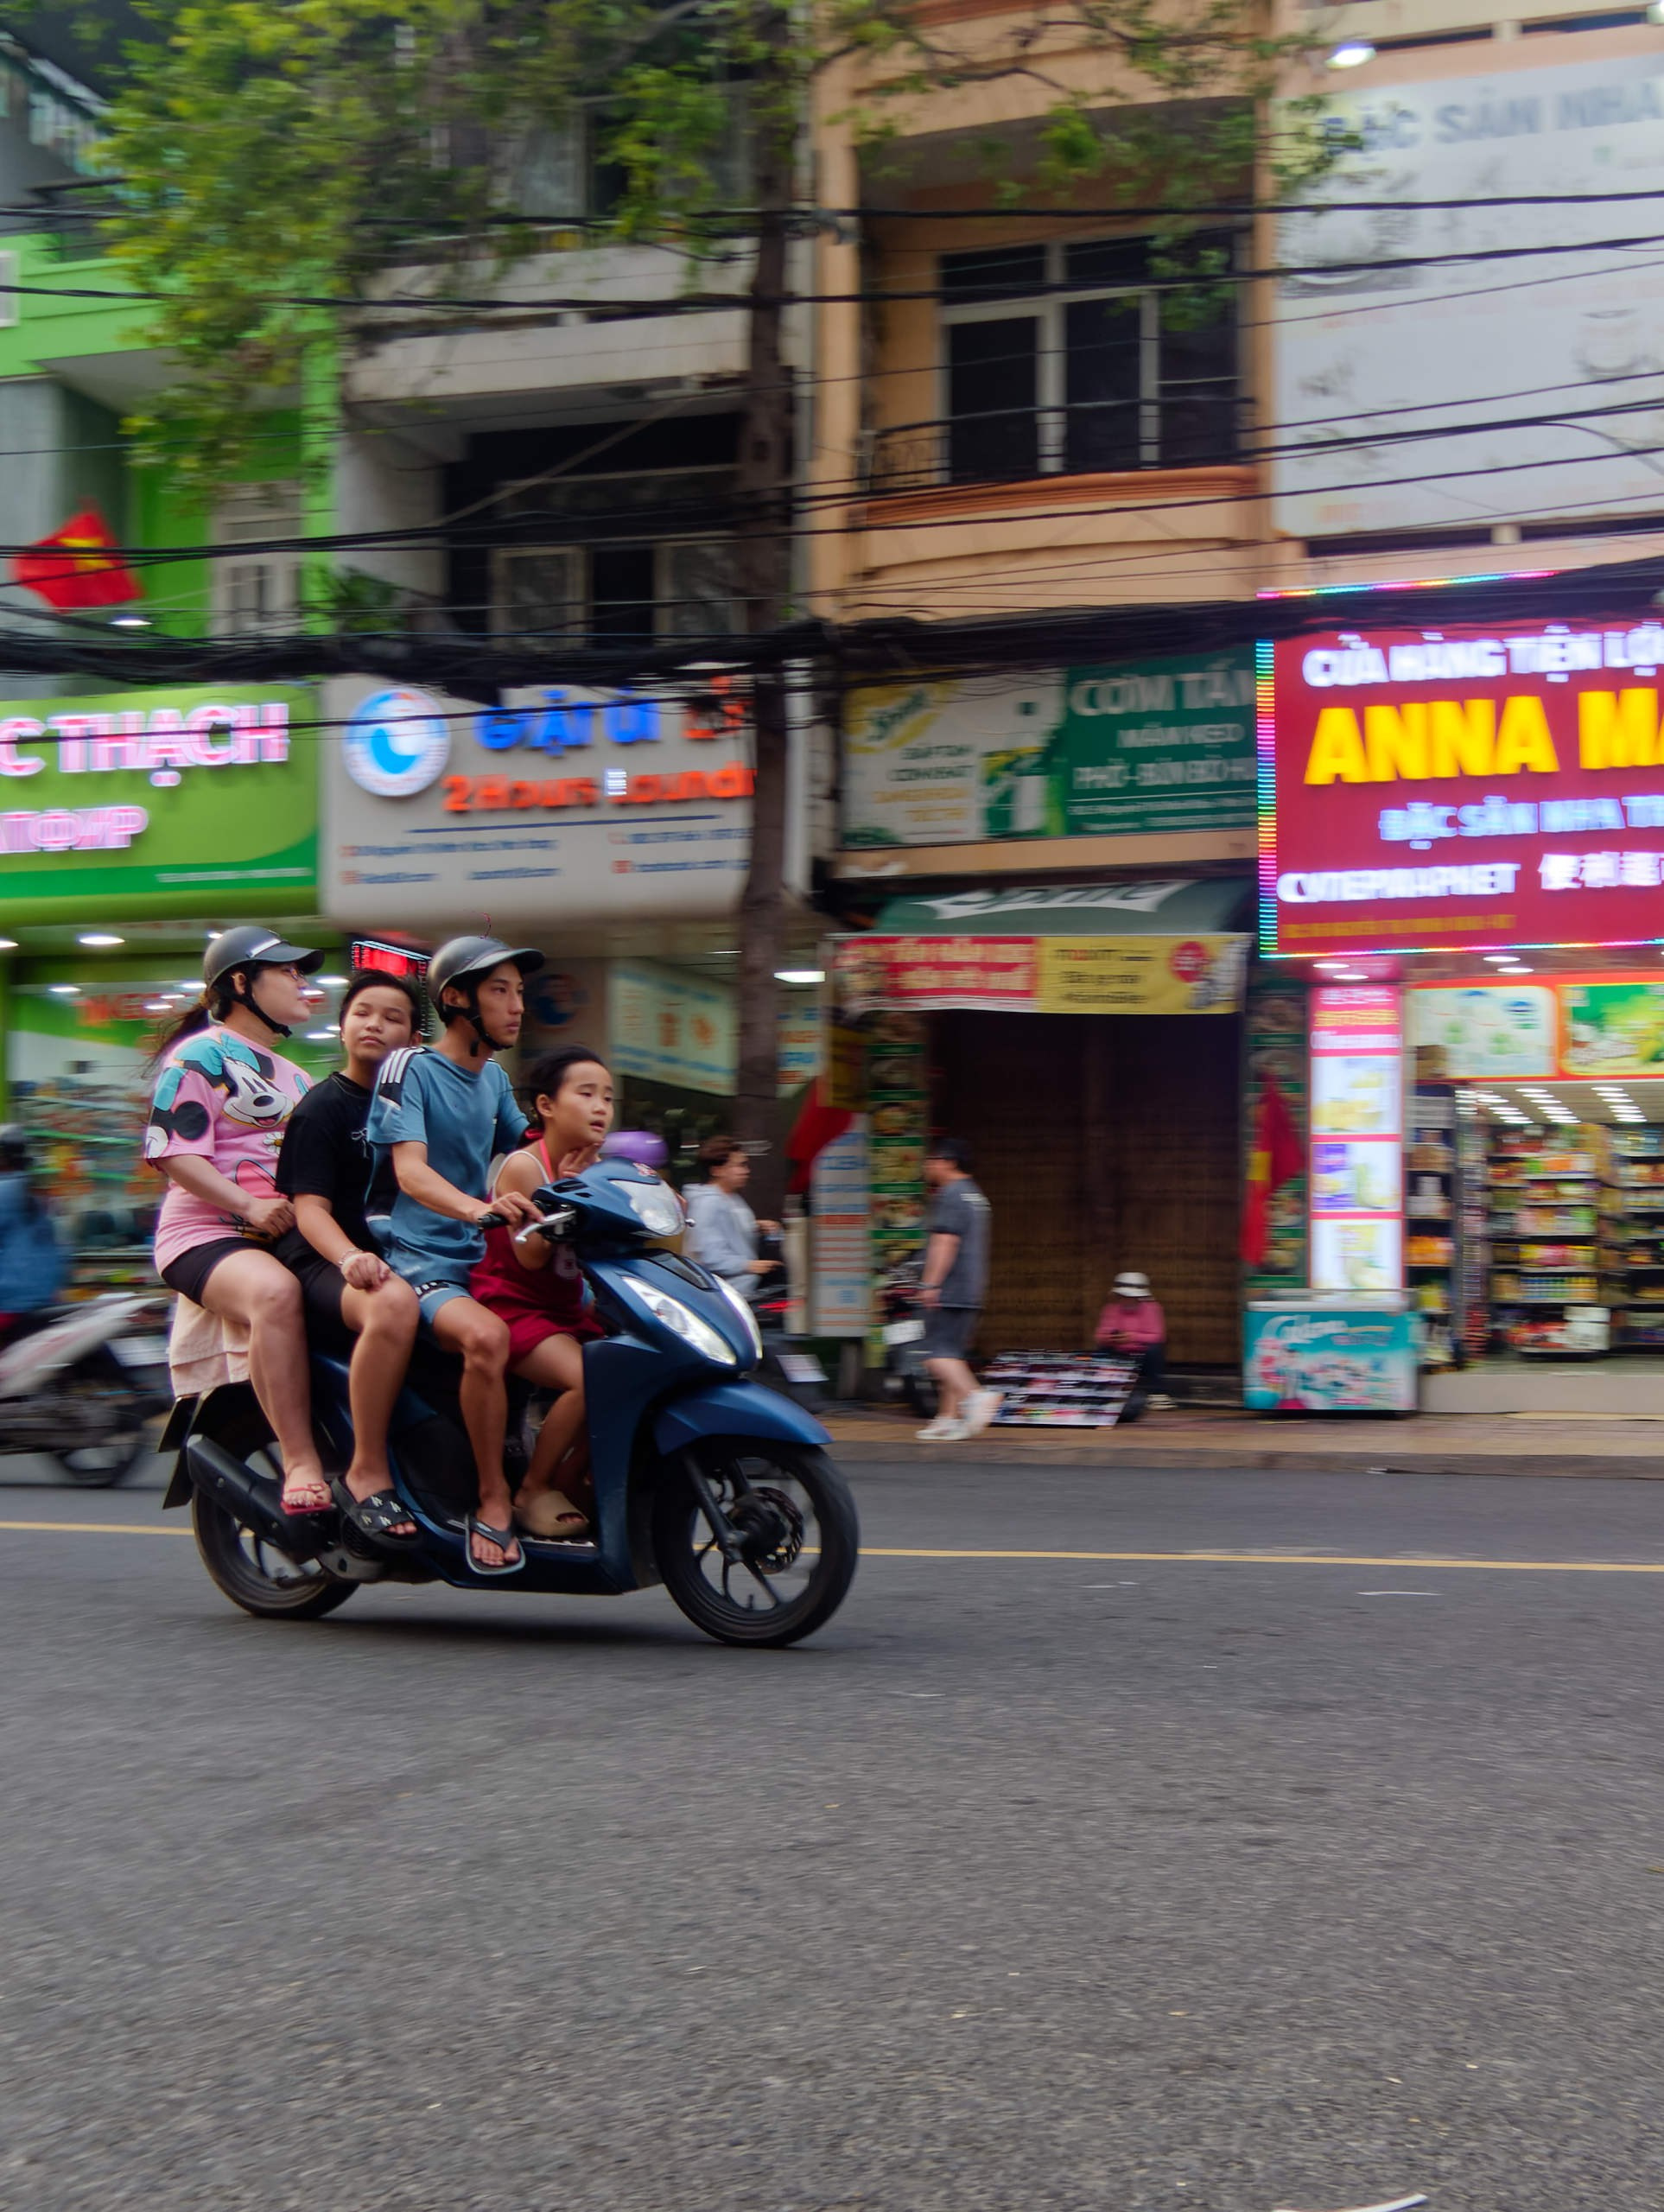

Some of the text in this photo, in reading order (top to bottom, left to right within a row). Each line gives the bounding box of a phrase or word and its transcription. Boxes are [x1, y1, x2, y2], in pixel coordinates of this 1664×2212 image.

[47, 702, 290, 787] THẠCH
[1303, 688, 1664, 785] ANNA M
